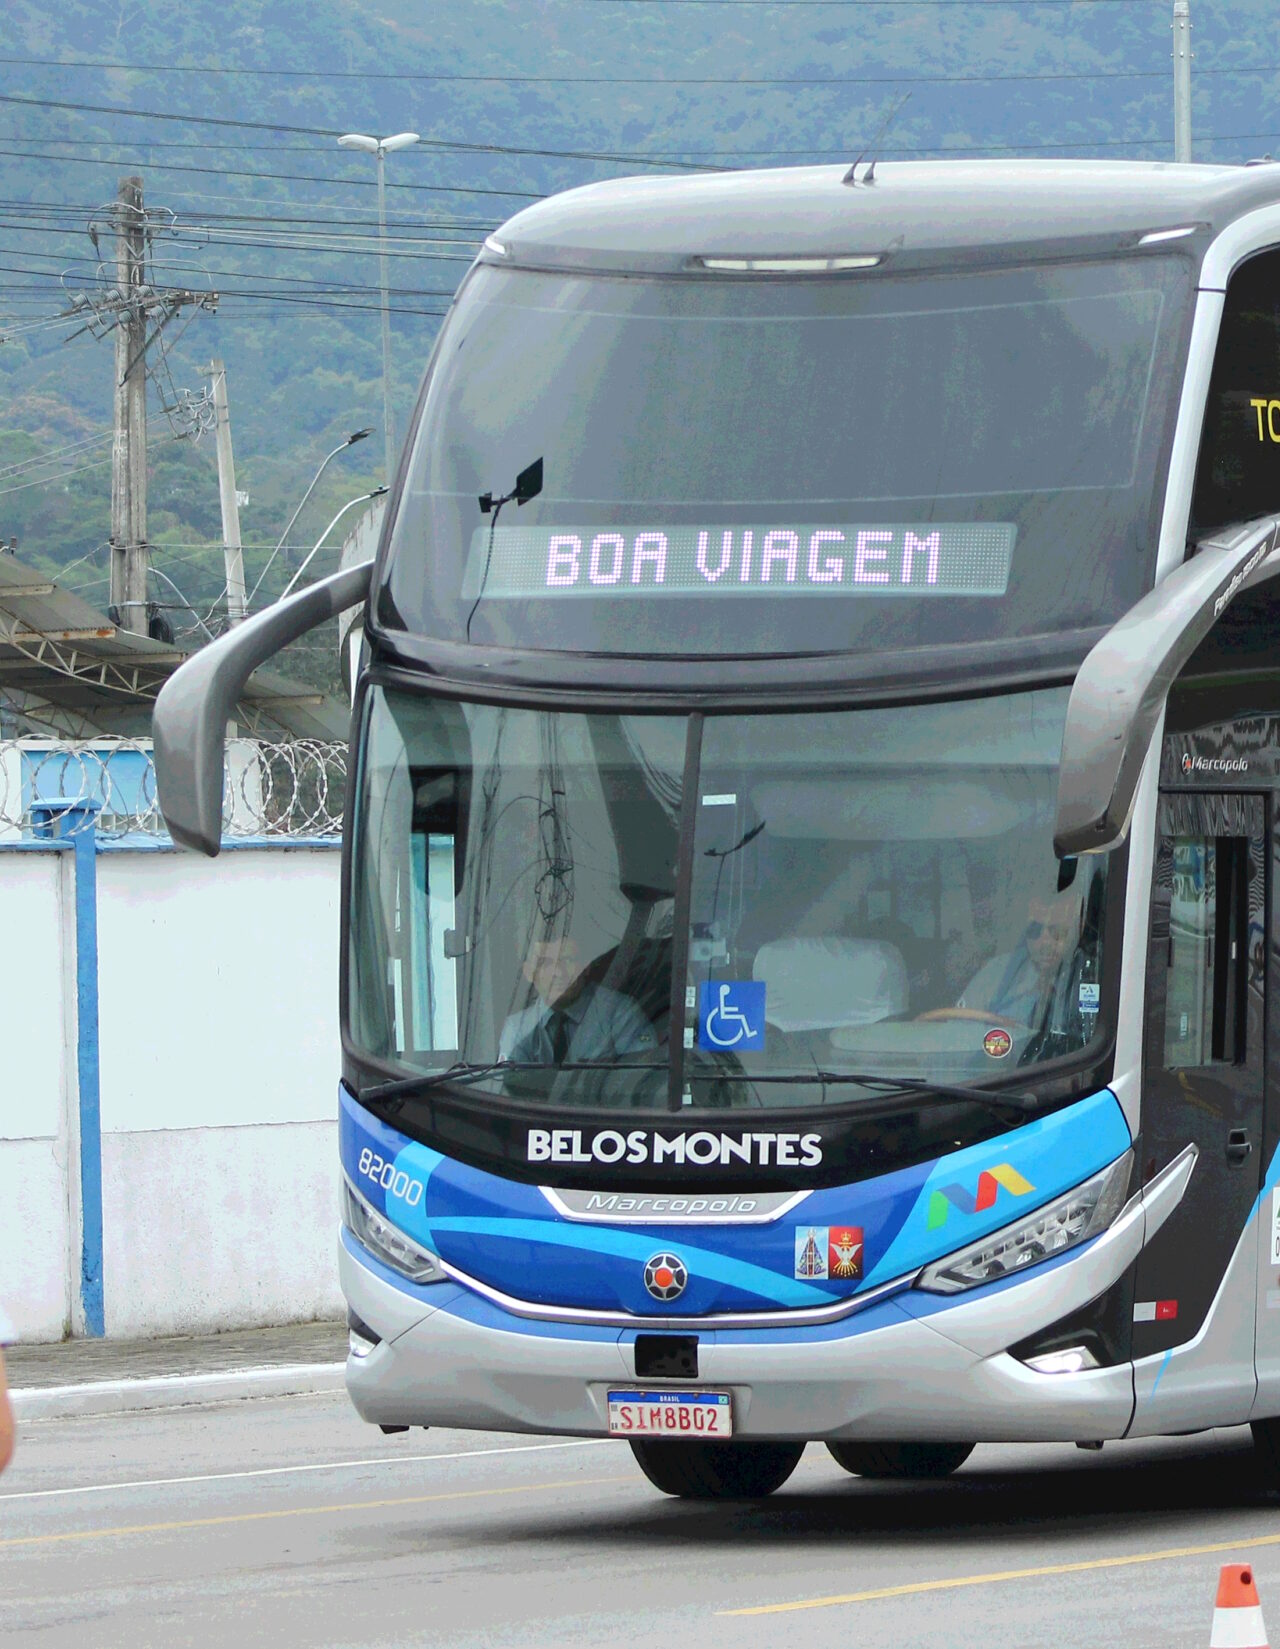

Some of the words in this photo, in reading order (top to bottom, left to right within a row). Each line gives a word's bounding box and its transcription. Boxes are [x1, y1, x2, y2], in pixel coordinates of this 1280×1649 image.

[545, 532, 668, 586] BOA
[695, 529, 942, 584] VIAGEM
[1191, 756, 1249, 774] Marcopolo
[358, 1147, 424, 1207] 82000
[585, 1193, 757, 1215] Marcopolo
[659, 1395, 680, 1403] BRASIL
[619, 1405, 718, 1432] SIM8B02
